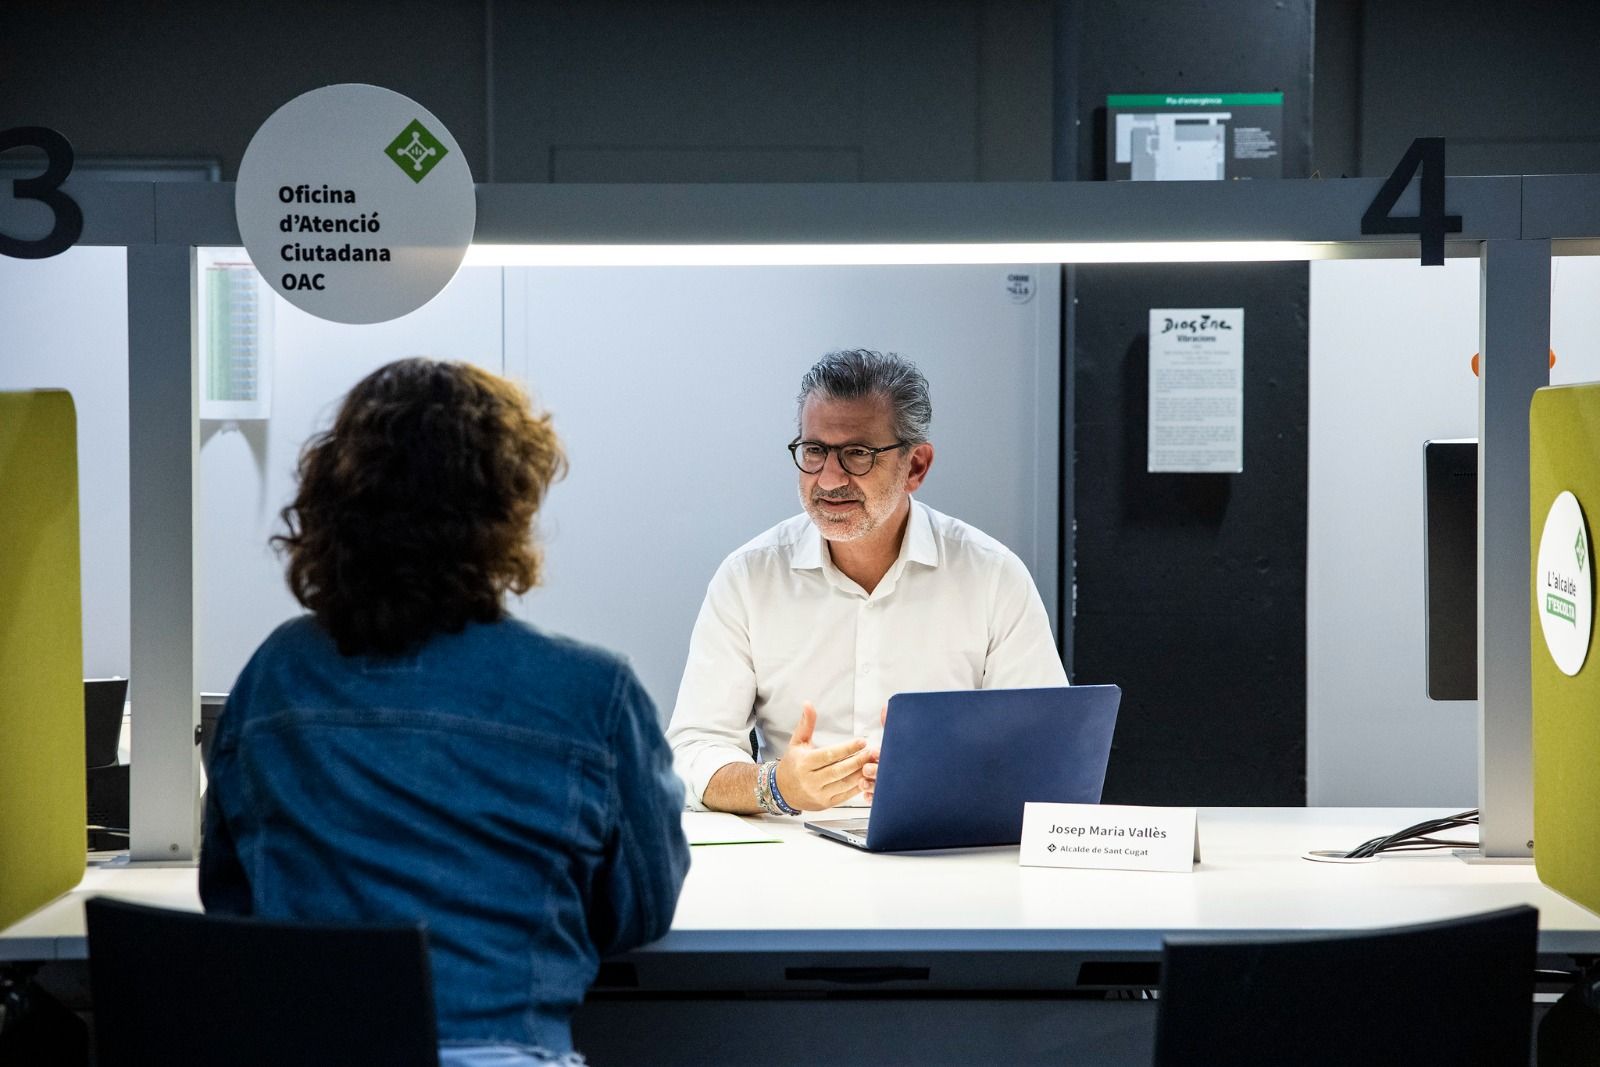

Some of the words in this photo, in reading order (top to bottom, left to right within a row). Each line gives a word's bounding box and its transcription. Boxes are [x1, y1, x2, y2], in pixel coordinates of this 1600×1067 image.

[0, 126, 83, 260] 3
[278, 184, 356, 203] Oficina
[1361, 137, 1462, 266] 4
[279, 211, 380, 232] d’Atenció
[280, 242, 391, 262] Ciutadana
[281, 273, 325, 290] OAC
[1547, 571, 1577, 597] L'alcalde
[1048, 824, 1086, 837] Josep
[1089, 825, 1125, 837] Maria
[1128, 827, 1167, 838] Vallès
[1060, 845, 1090, 854] Alcalde
[1091, 846, 1102, 854] de
[1104, 847, 1122, 855] Sant
[1124, 848, 1149, 857] Cugat
